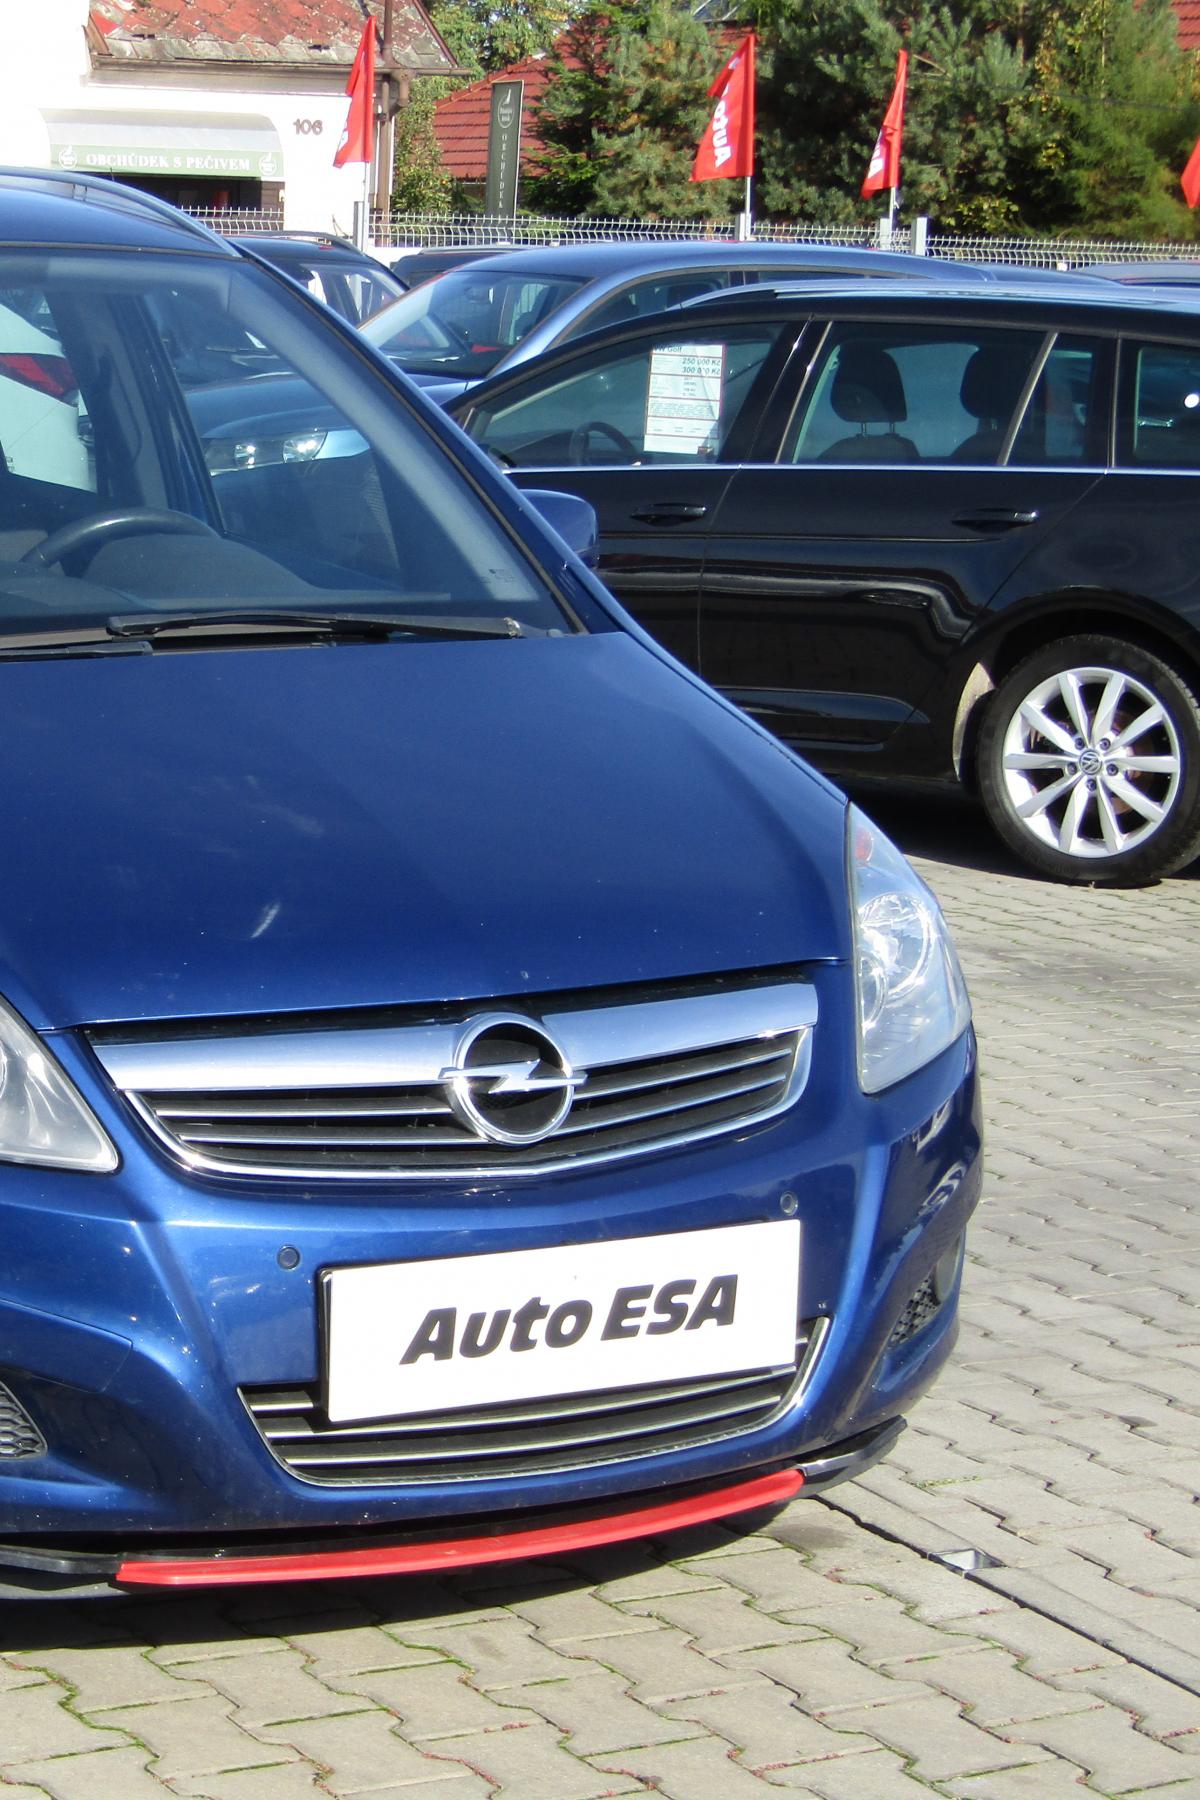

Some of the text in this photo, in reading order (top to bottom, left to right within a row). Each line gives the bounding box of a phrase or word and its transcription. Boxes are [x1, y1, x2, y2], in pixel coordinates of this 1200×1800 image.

[293, 119, 323, 135] 106
[86, 152, 251, 171] OBCHŮDEK S PEČIVEM
[399, 1273, 739, 1365] Auto ESA
